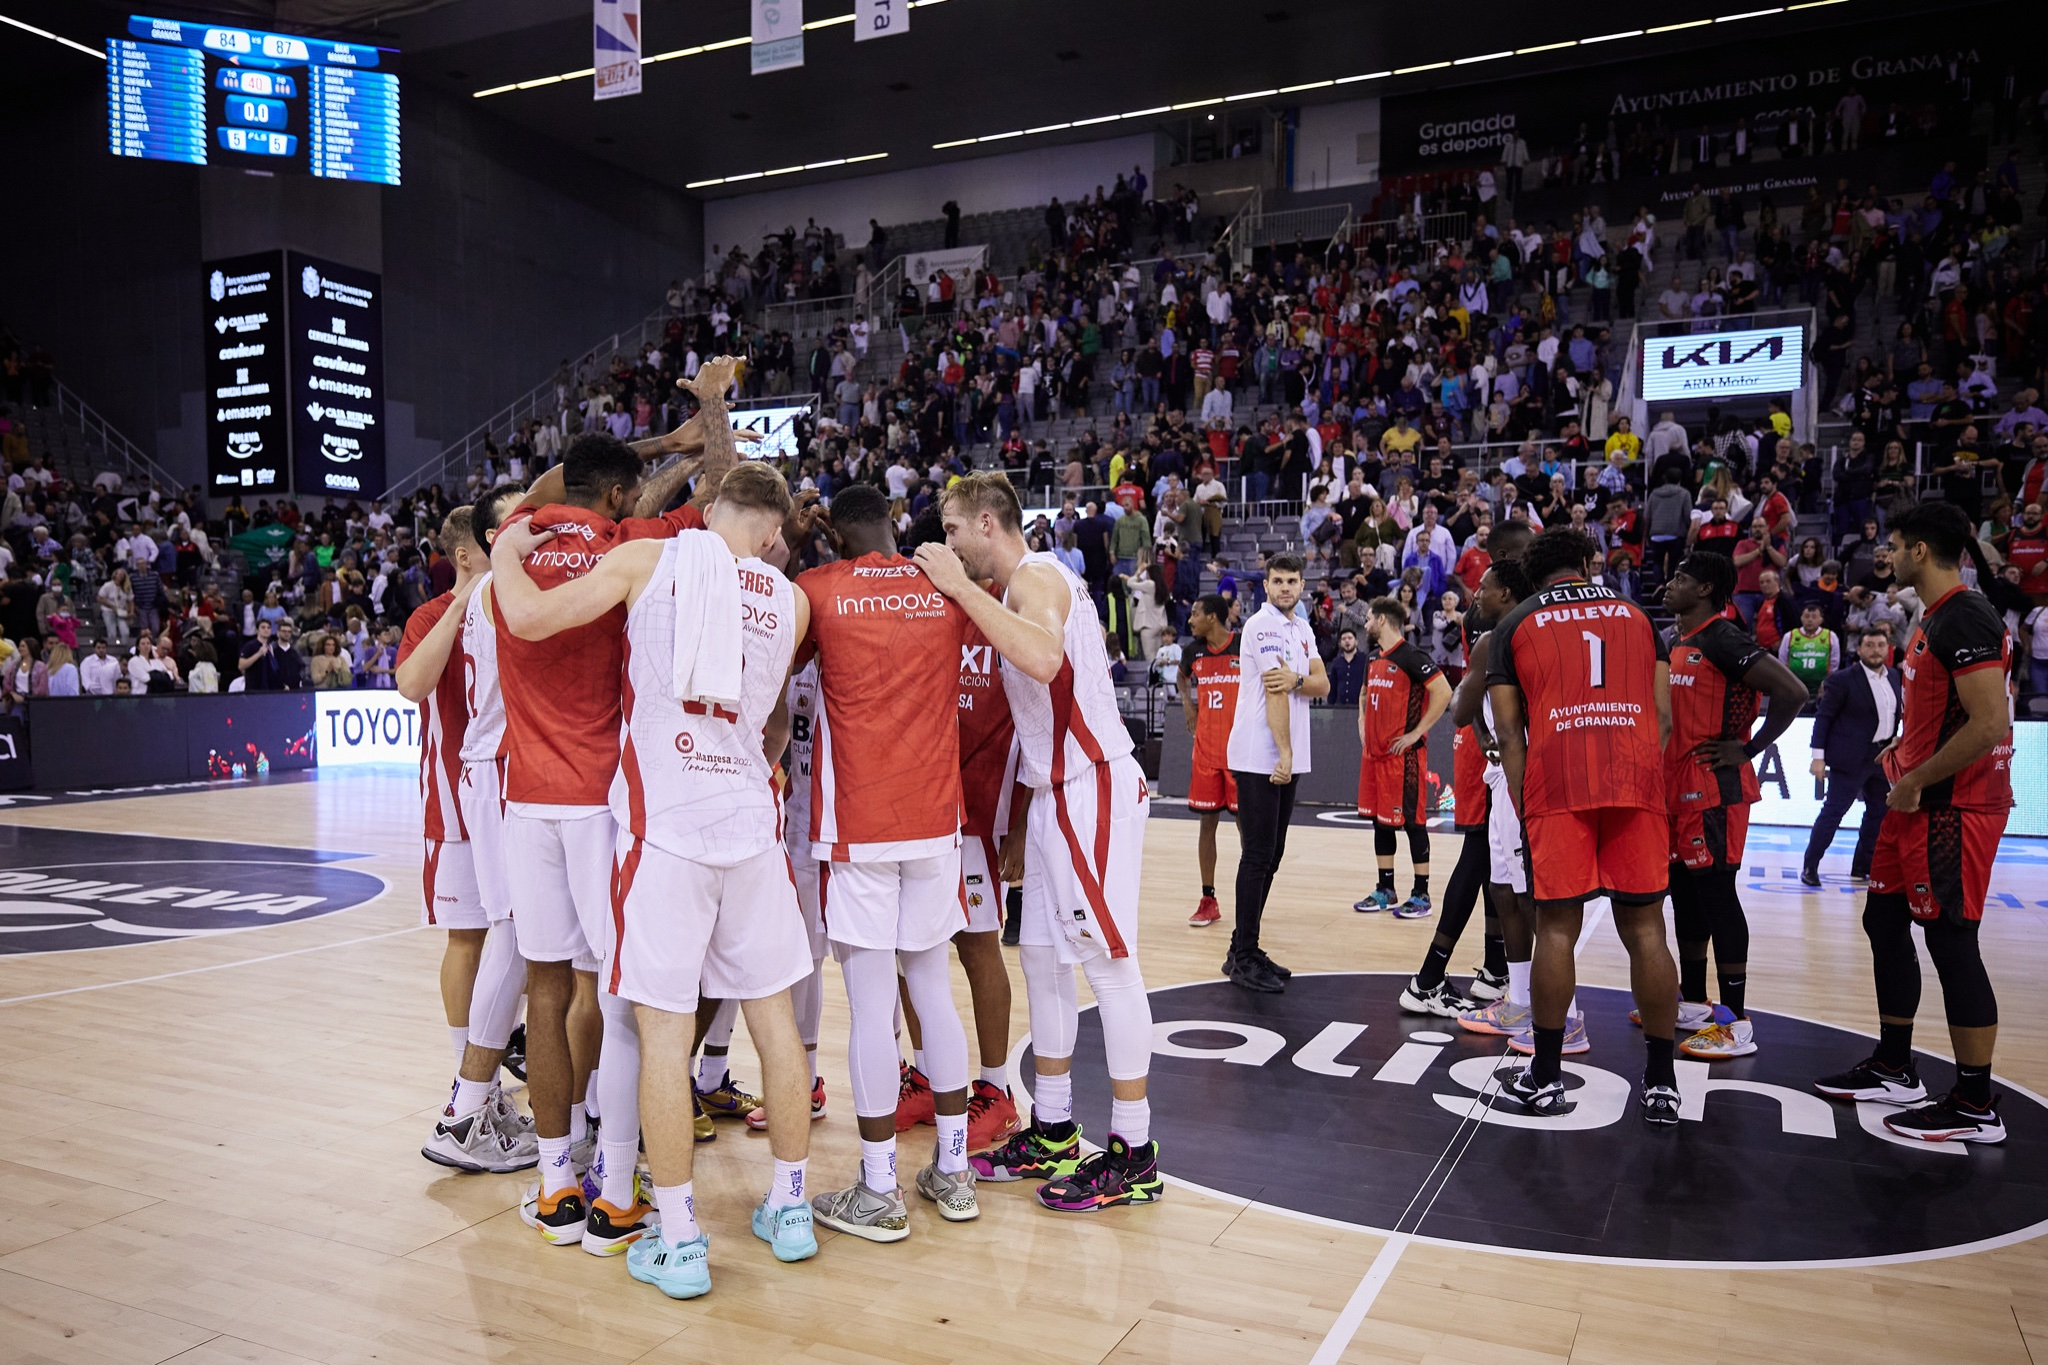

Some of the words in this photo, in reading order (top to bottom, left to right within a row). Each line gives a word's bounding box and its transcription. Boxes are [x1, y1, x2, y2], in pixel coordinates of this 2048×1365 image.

[219, 32, 236, 48] 84
[276, 40, 292, 55] 87
[248, 77, 263, 91] 40
[1610, 73, 1798, 116] AYUNTAMIENTO
[1807, 66, 1841, 87] DE
[1850, 48, 1982, 81] GRANAA
[243, 102, 269, 123] 0.0
[1418, 113, 1516, 140] Granada
[233, 133, 241, 146] 5
[273, 138, 281, 151] 5
[1418, 139, 1439, 156] es
[1440, 131, 1514, 155] deporte
[1662, 336, 1784, 370] KIA
[319, 378, 372, 400] emasagra
[1683, 376, 1714, 390] ARM
[225, 404, 272, 420] emasagra
[228, 431, 261, 445] PULEVA
[323, 432, 360, 451] PULEVA
[836, 592, 945, 615] inmoovs
[1538, 586, 1616, 605] FELICIO
[905, 612, 914, 620] by
[915, 610, 946, 618] AVINENT
[1534, 604, 1632, 628] PULEVA
[742, 624, 775, 640] AVINENT
[1582, 630, 1606, 689] 1
[1802, 658, 1816, 669] 18
[958, 693, 973, 711] SA
[1207, 690, 1223, 709] 12
[1370, 693, 1379, 711] 4
[1549, 702, 1642, 721] AYUNTAMIENTO
[326, 708, 420, 748] TOYOT
[1556, 719, 1572, 732] DE
[1574, 716, 1636, 729] GRANADA
[682, 755, 742, 776] Transforma
[696, 751, 732, 764] Manresa
